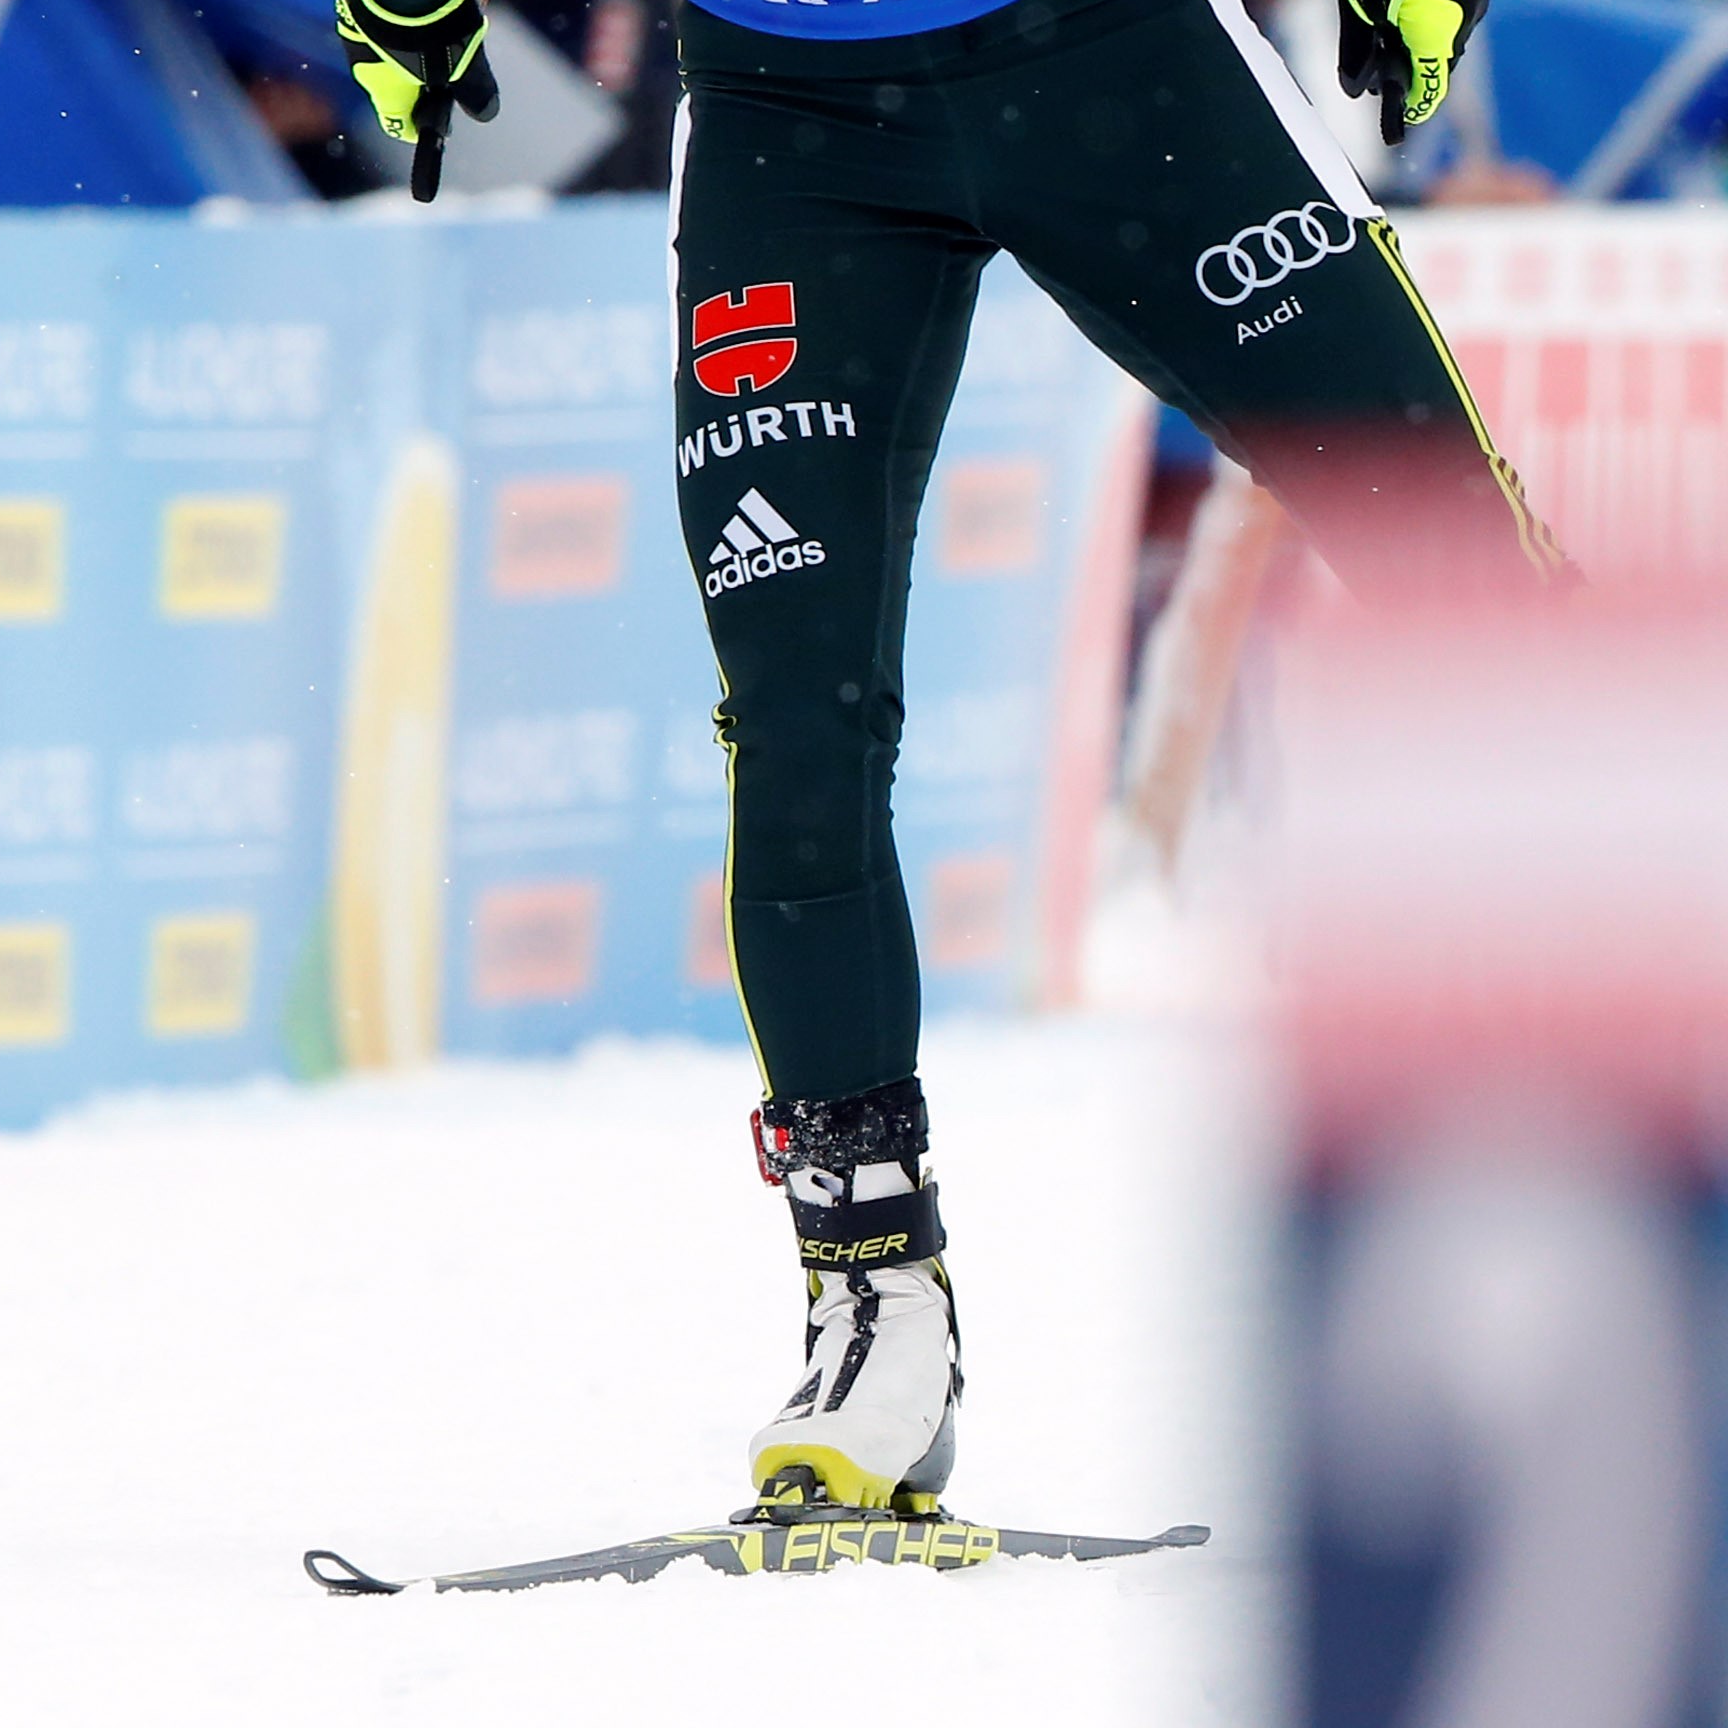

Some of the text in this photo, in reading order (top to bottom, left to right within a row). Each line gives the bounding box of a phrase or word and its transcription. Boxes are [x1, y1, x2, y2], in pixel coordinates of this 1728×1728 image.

[1235, 295, 1304, 345] Audi
[677, 401, 857, 479] WÜRTH
[704, 540, 826, 599] adidas
[780, 1522, 1001, 1574] FISCHER
